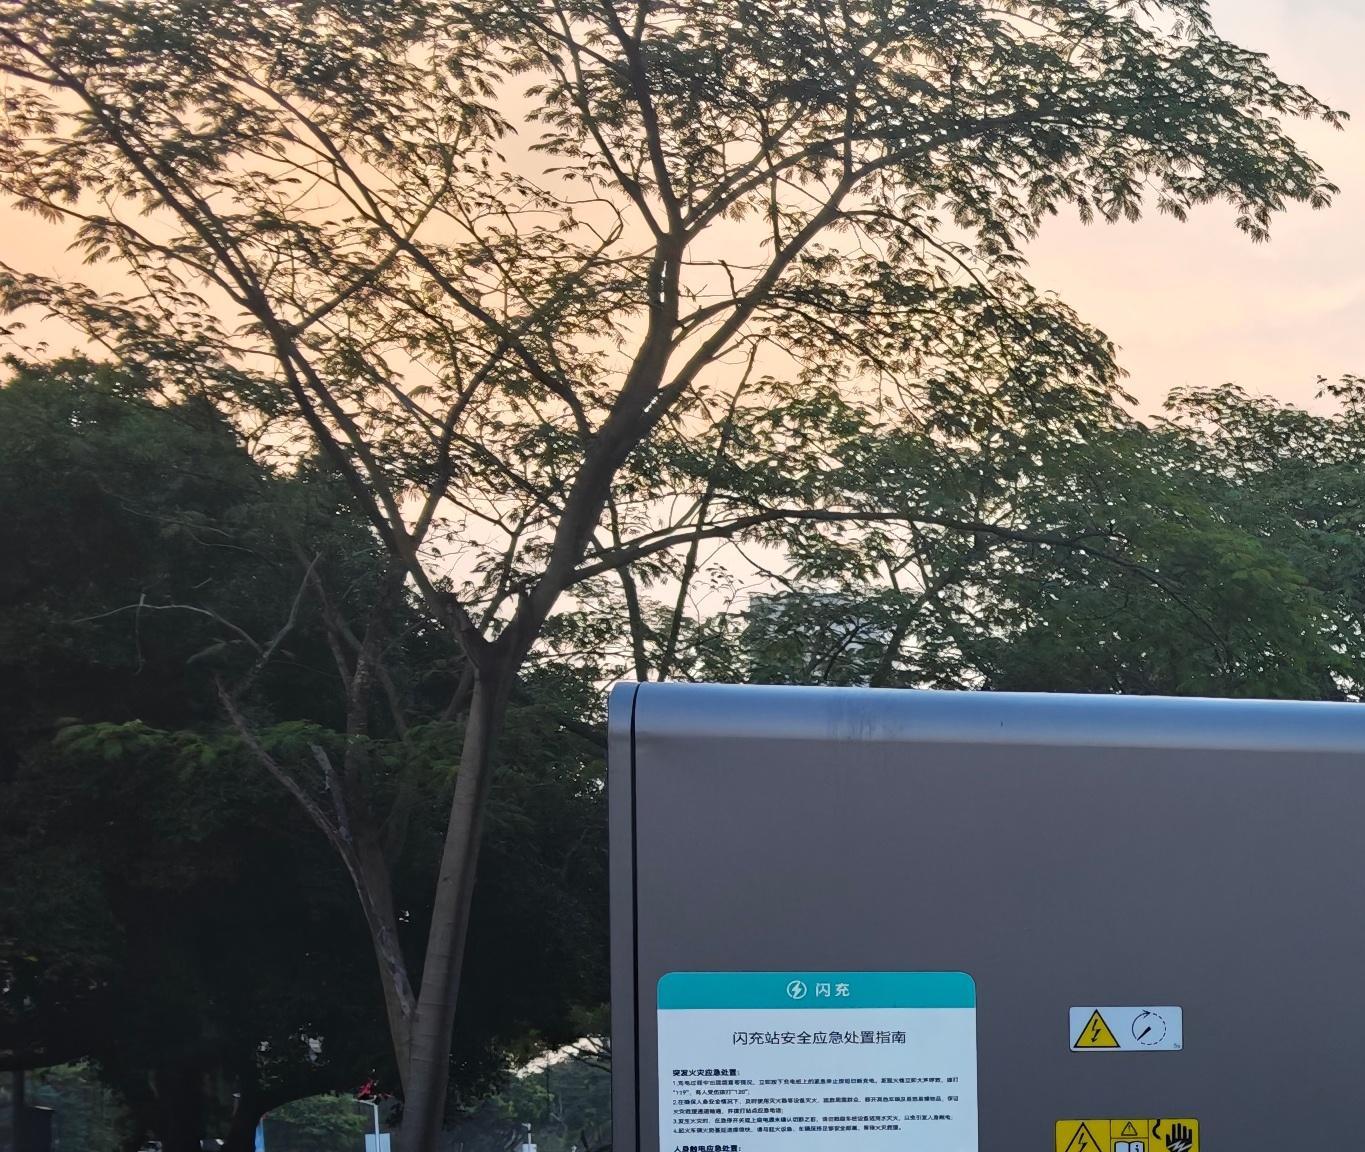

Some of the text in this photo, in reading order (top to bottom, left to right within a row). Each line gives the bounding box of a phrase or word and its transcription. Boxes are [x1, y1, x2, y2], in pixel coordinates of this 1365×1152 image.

[815, 982, 850, 997] 闪充
[732, 1030, 907, 1046] 闪充站安全应急处置指南
